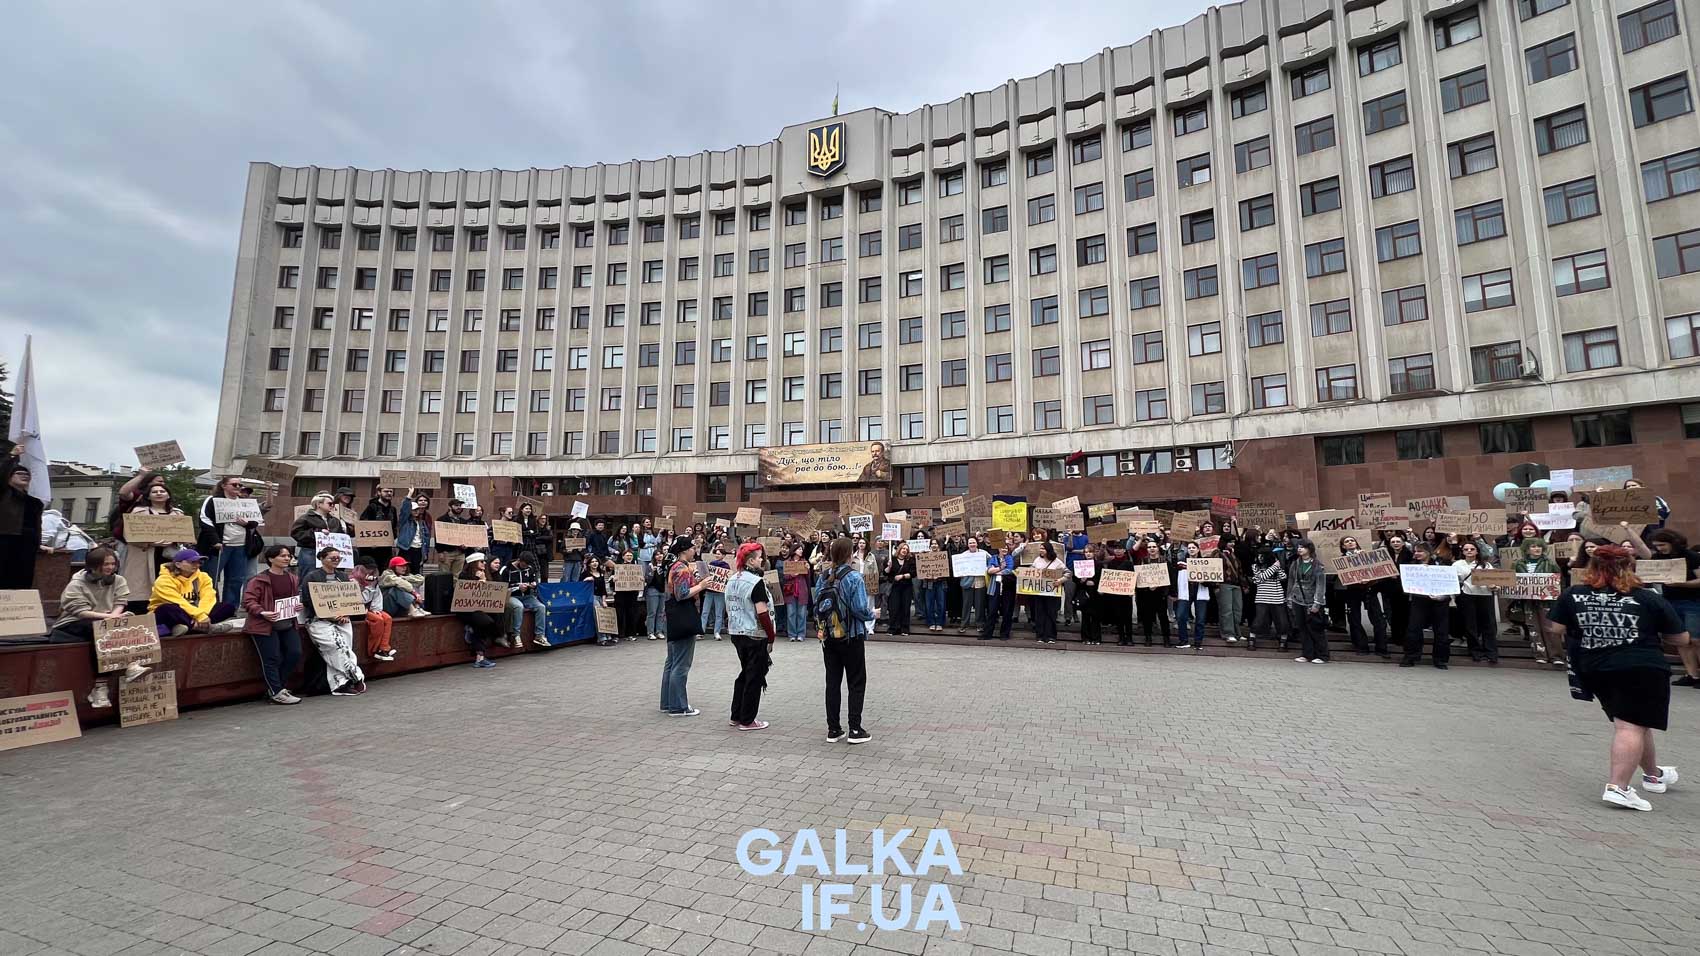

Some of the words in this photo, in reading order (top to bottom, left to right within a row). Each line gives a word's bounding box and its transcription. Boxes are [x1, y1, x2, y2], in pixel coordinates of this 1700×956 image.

[818, 455, 841, 463] тіло
[359, 530, 390, 538] 15150
[1189, 570, 1223, 581] СОВОК
[321, 583, 359, 593] ПРОЧИТАЛА
[463, 582, 480, 590] САМА
[471, 591, 492, 599] КОЛИ
[327, 600, 338, 611] НЕ
[454, 599, 504, 609] РОЗЛУЧАТИСЬ
[1576, 611, 1640, 629] HEAVY
[1579, 626, 1640, 638] UCKING
